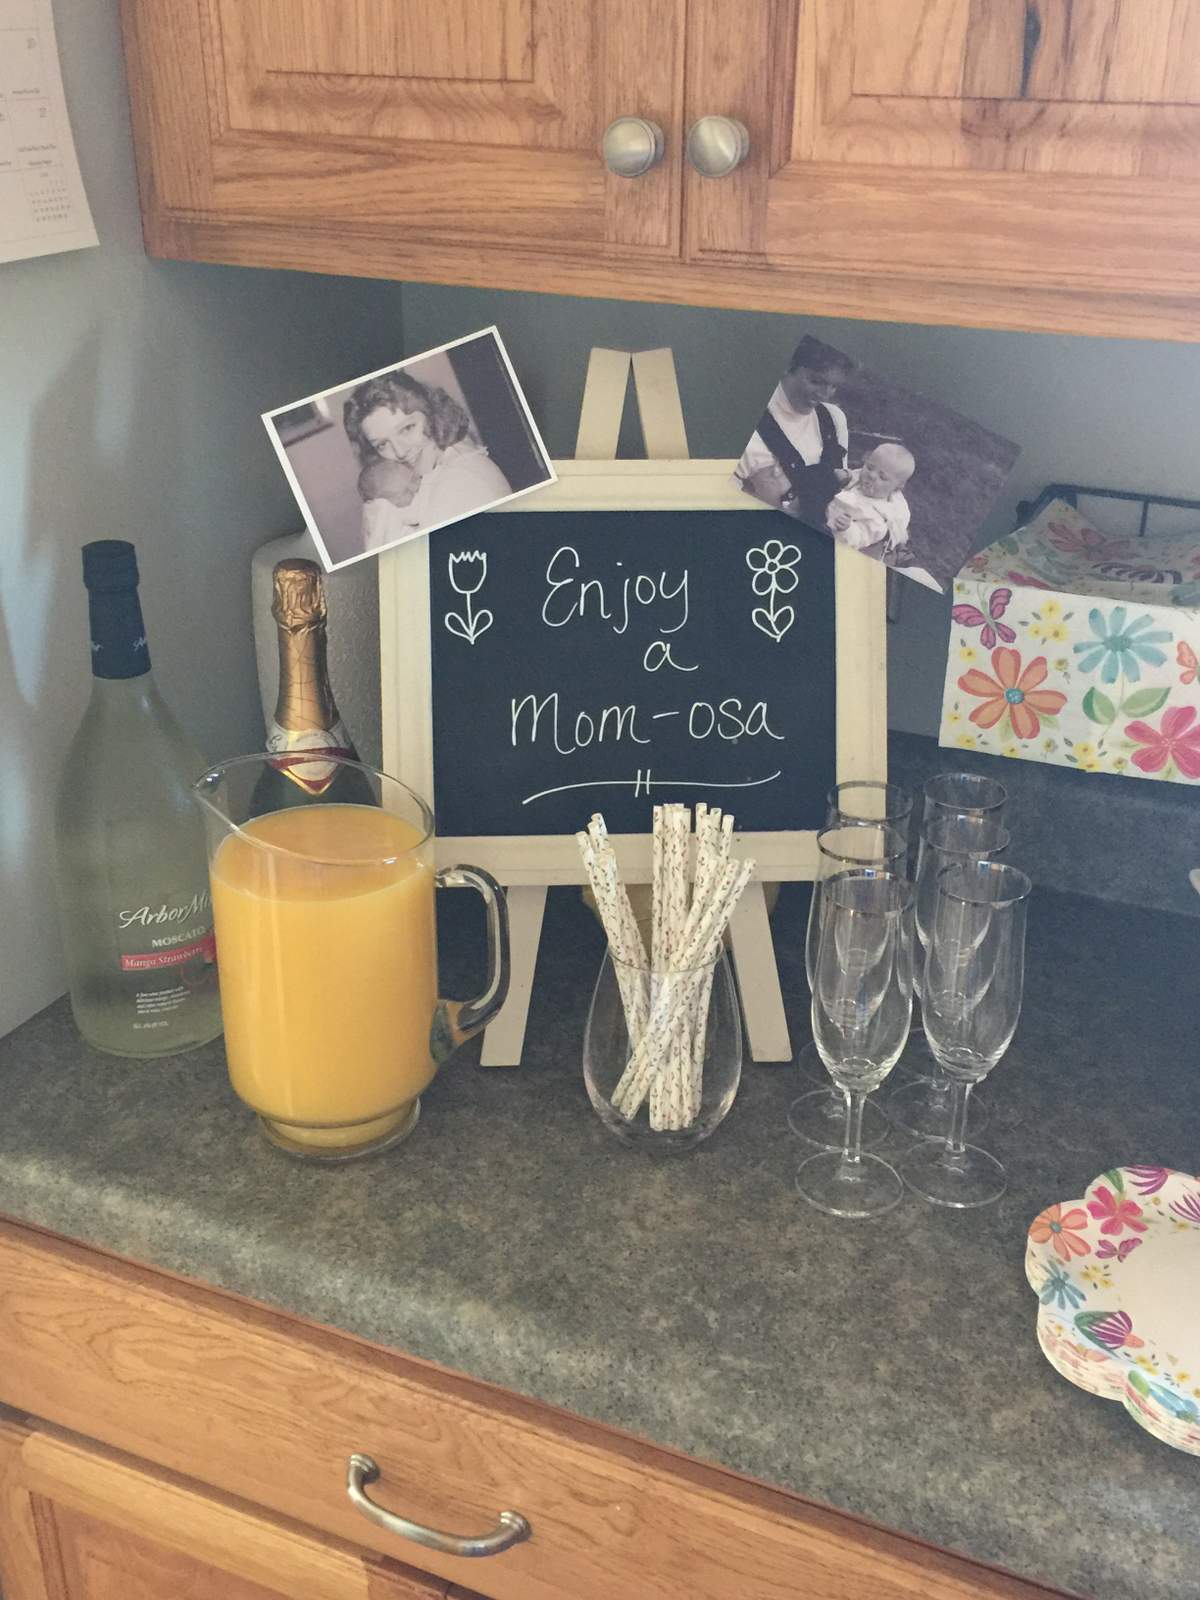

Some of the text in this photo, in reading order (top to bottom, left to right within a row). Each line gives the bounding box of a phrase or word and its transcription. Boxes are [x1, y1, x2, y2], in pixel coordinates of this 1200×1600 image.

[542, 545, 689, 634] Enjoy
[642, 640, 700, 672] a
[510, 691, 785, 755] Mom-osa
[151, 926, 206, 948] MOSCATO
[125, 958, 156, 969] Mango
